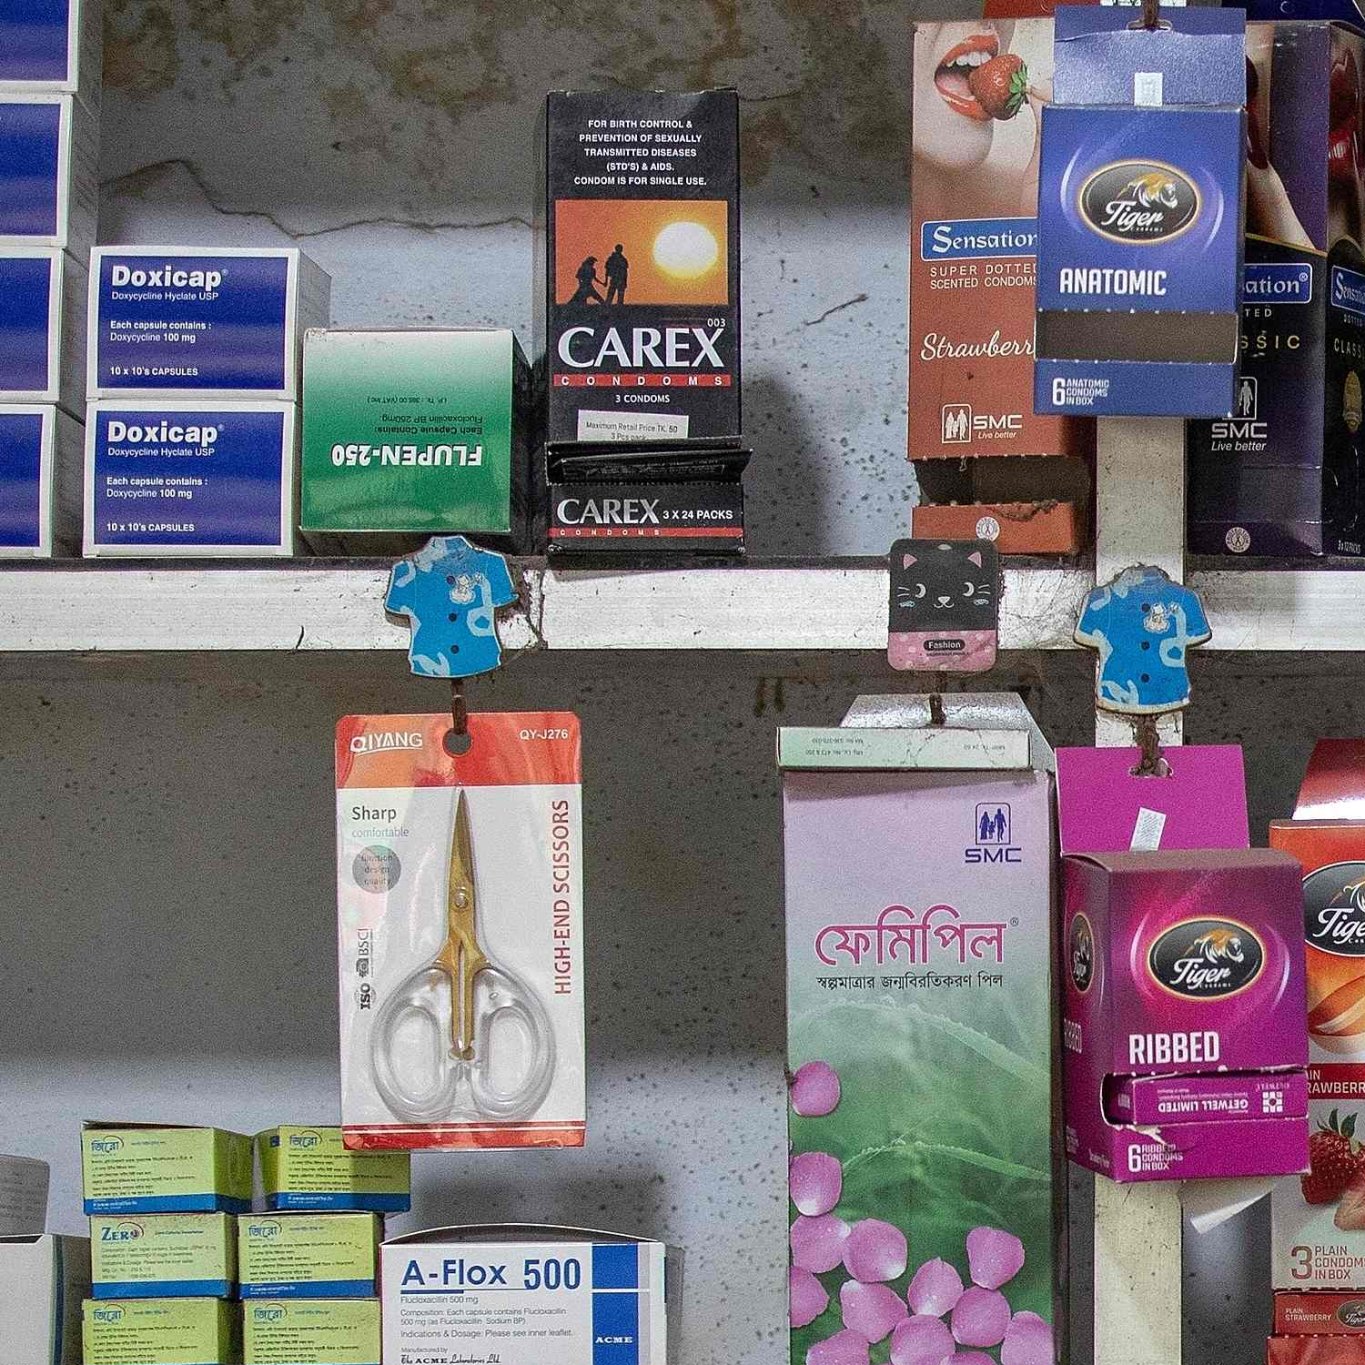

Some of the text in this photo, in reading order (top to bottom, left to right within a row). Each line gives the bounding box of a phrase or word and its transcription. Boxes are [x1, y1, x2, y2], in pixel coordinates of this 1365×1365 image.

[1100, 201, 1163, 231] Tiger
[111, 265, 222, 292] Doxicap
[1060, 268, 1167, 296] ANATOMIC
[557, 328, 725, 369] CAREX
[921, 332, 1034, 361] Strawberr
[110, 367, 121, 376] 10
[152, 367, 198, 376] CAPSULES
[107, 420, 218, 447] Doxicap
[973, 414, 1022, 429] SMC
[331, 443, 483, 467] FLUPEN-250
[556, 499, 660, 524] CAREX
[662, 510, 670, 519] 3
[681, 510, 694, 519] 24
[696, 510, 733, 519] PACKS
[350, 732, 423, 754] QIYANG
[352, 806, 397, 823] Sharp
[965, 848, 1022, 863] SMC
[551, 800, 572, 995] HIGH-END SCISSORS
[814, 904, 1007, 966] ফেমিপিল
[978, 970, 1003, 988] পিল
[1169, 958, 1231, 990] Tiger
[1129, 1031, 1220, 1065] RIBBED
[401, 1259, 581, 1290] A-Flox 500
[595, 1336, 633, 1344] ACME
